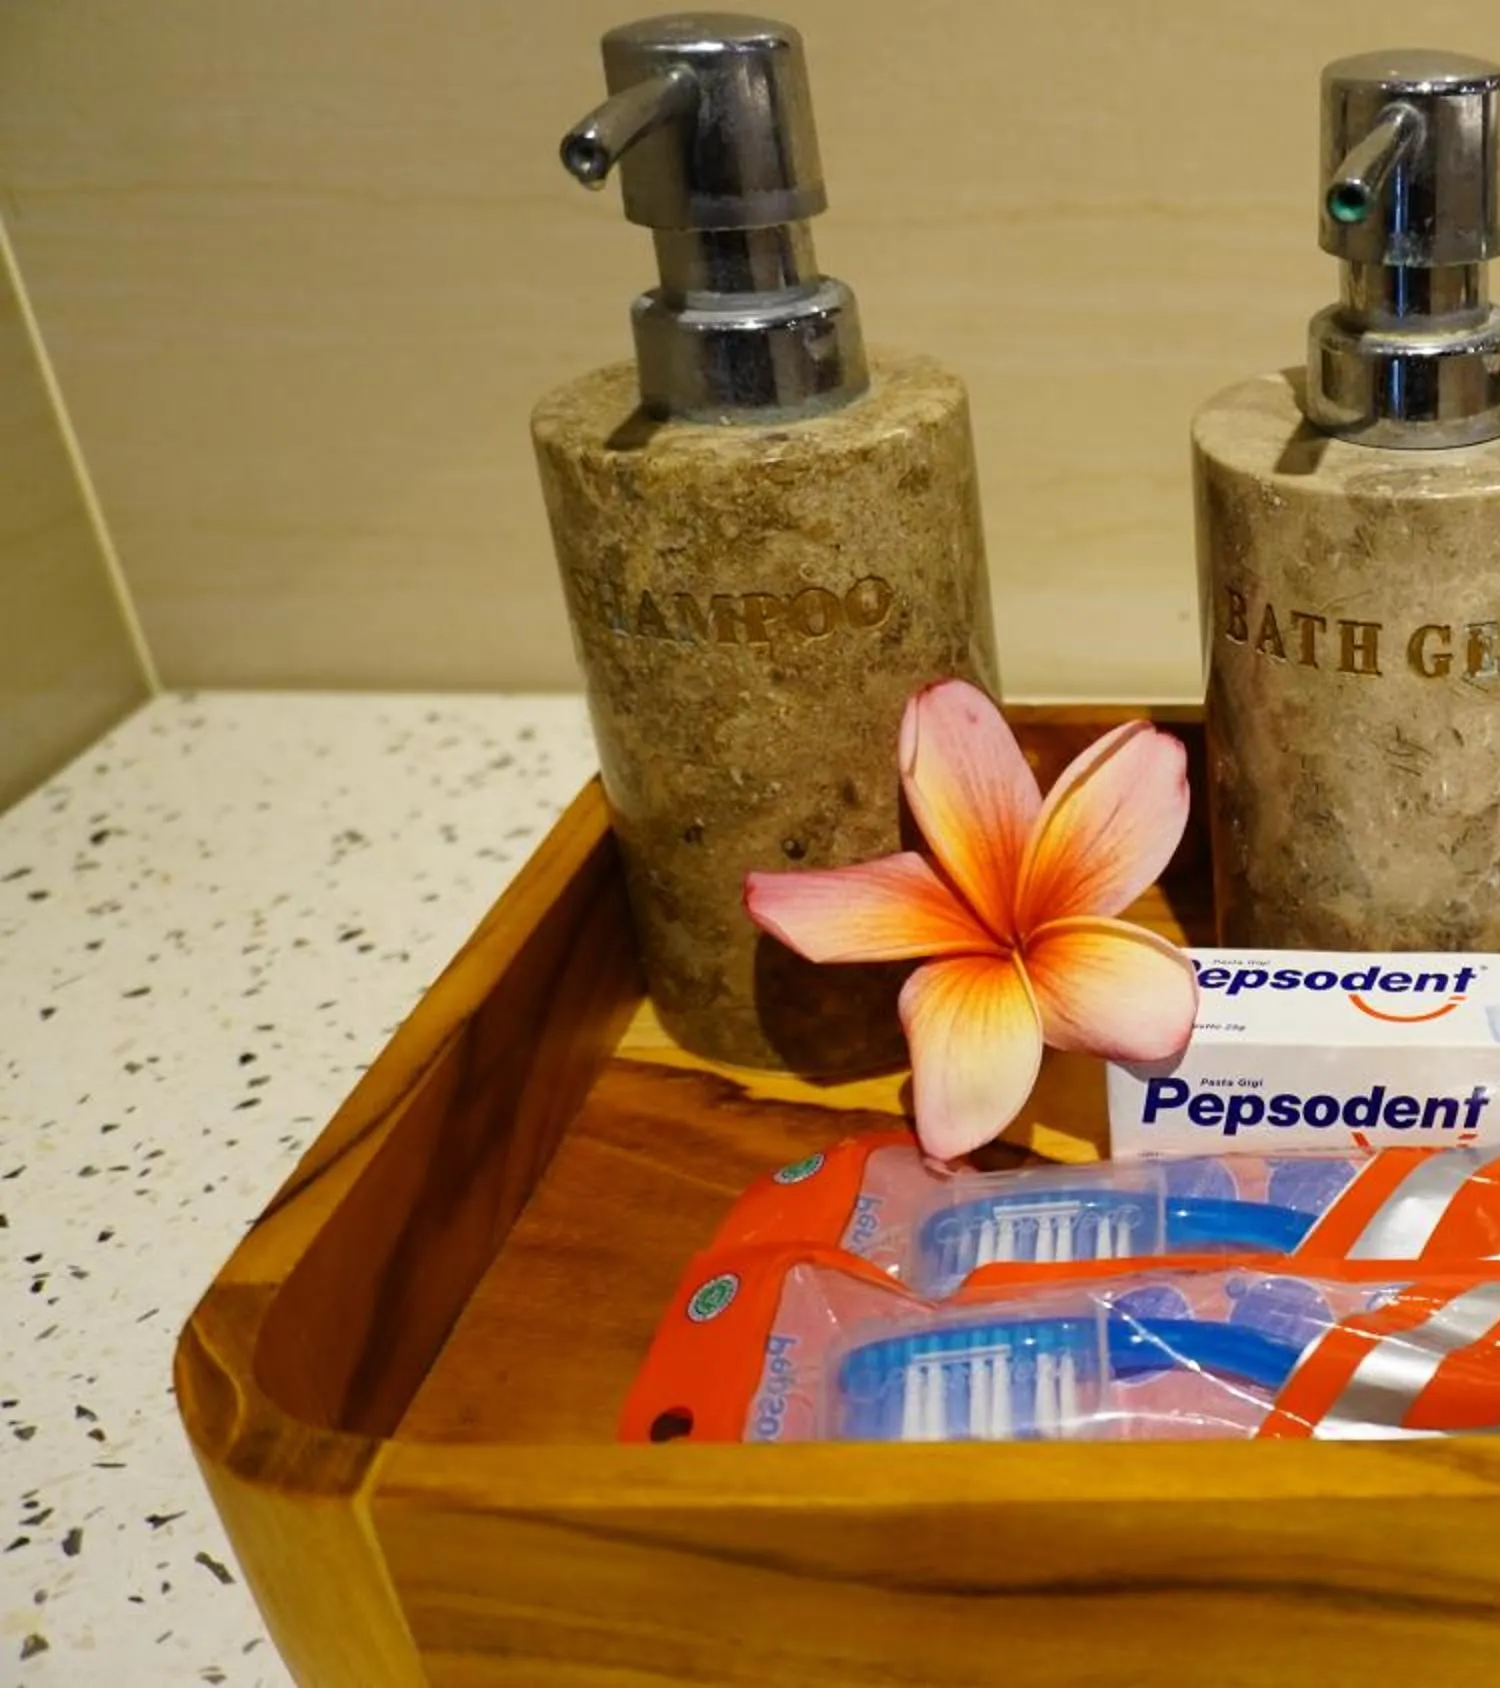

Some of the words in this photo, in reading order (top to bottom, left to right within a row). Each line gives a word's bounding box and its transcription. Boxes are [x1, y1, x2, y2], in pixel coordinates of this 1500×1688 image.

[1224, 586, 1384, 678] BATH
[1191, 959, 1477, 996] epsodent
[1141, 1076, 1491, 1137] Pepsodent
[1200, 1077, 1234, 1088] Pasta
[1237, 1078, 1264, 1089] Gigi
